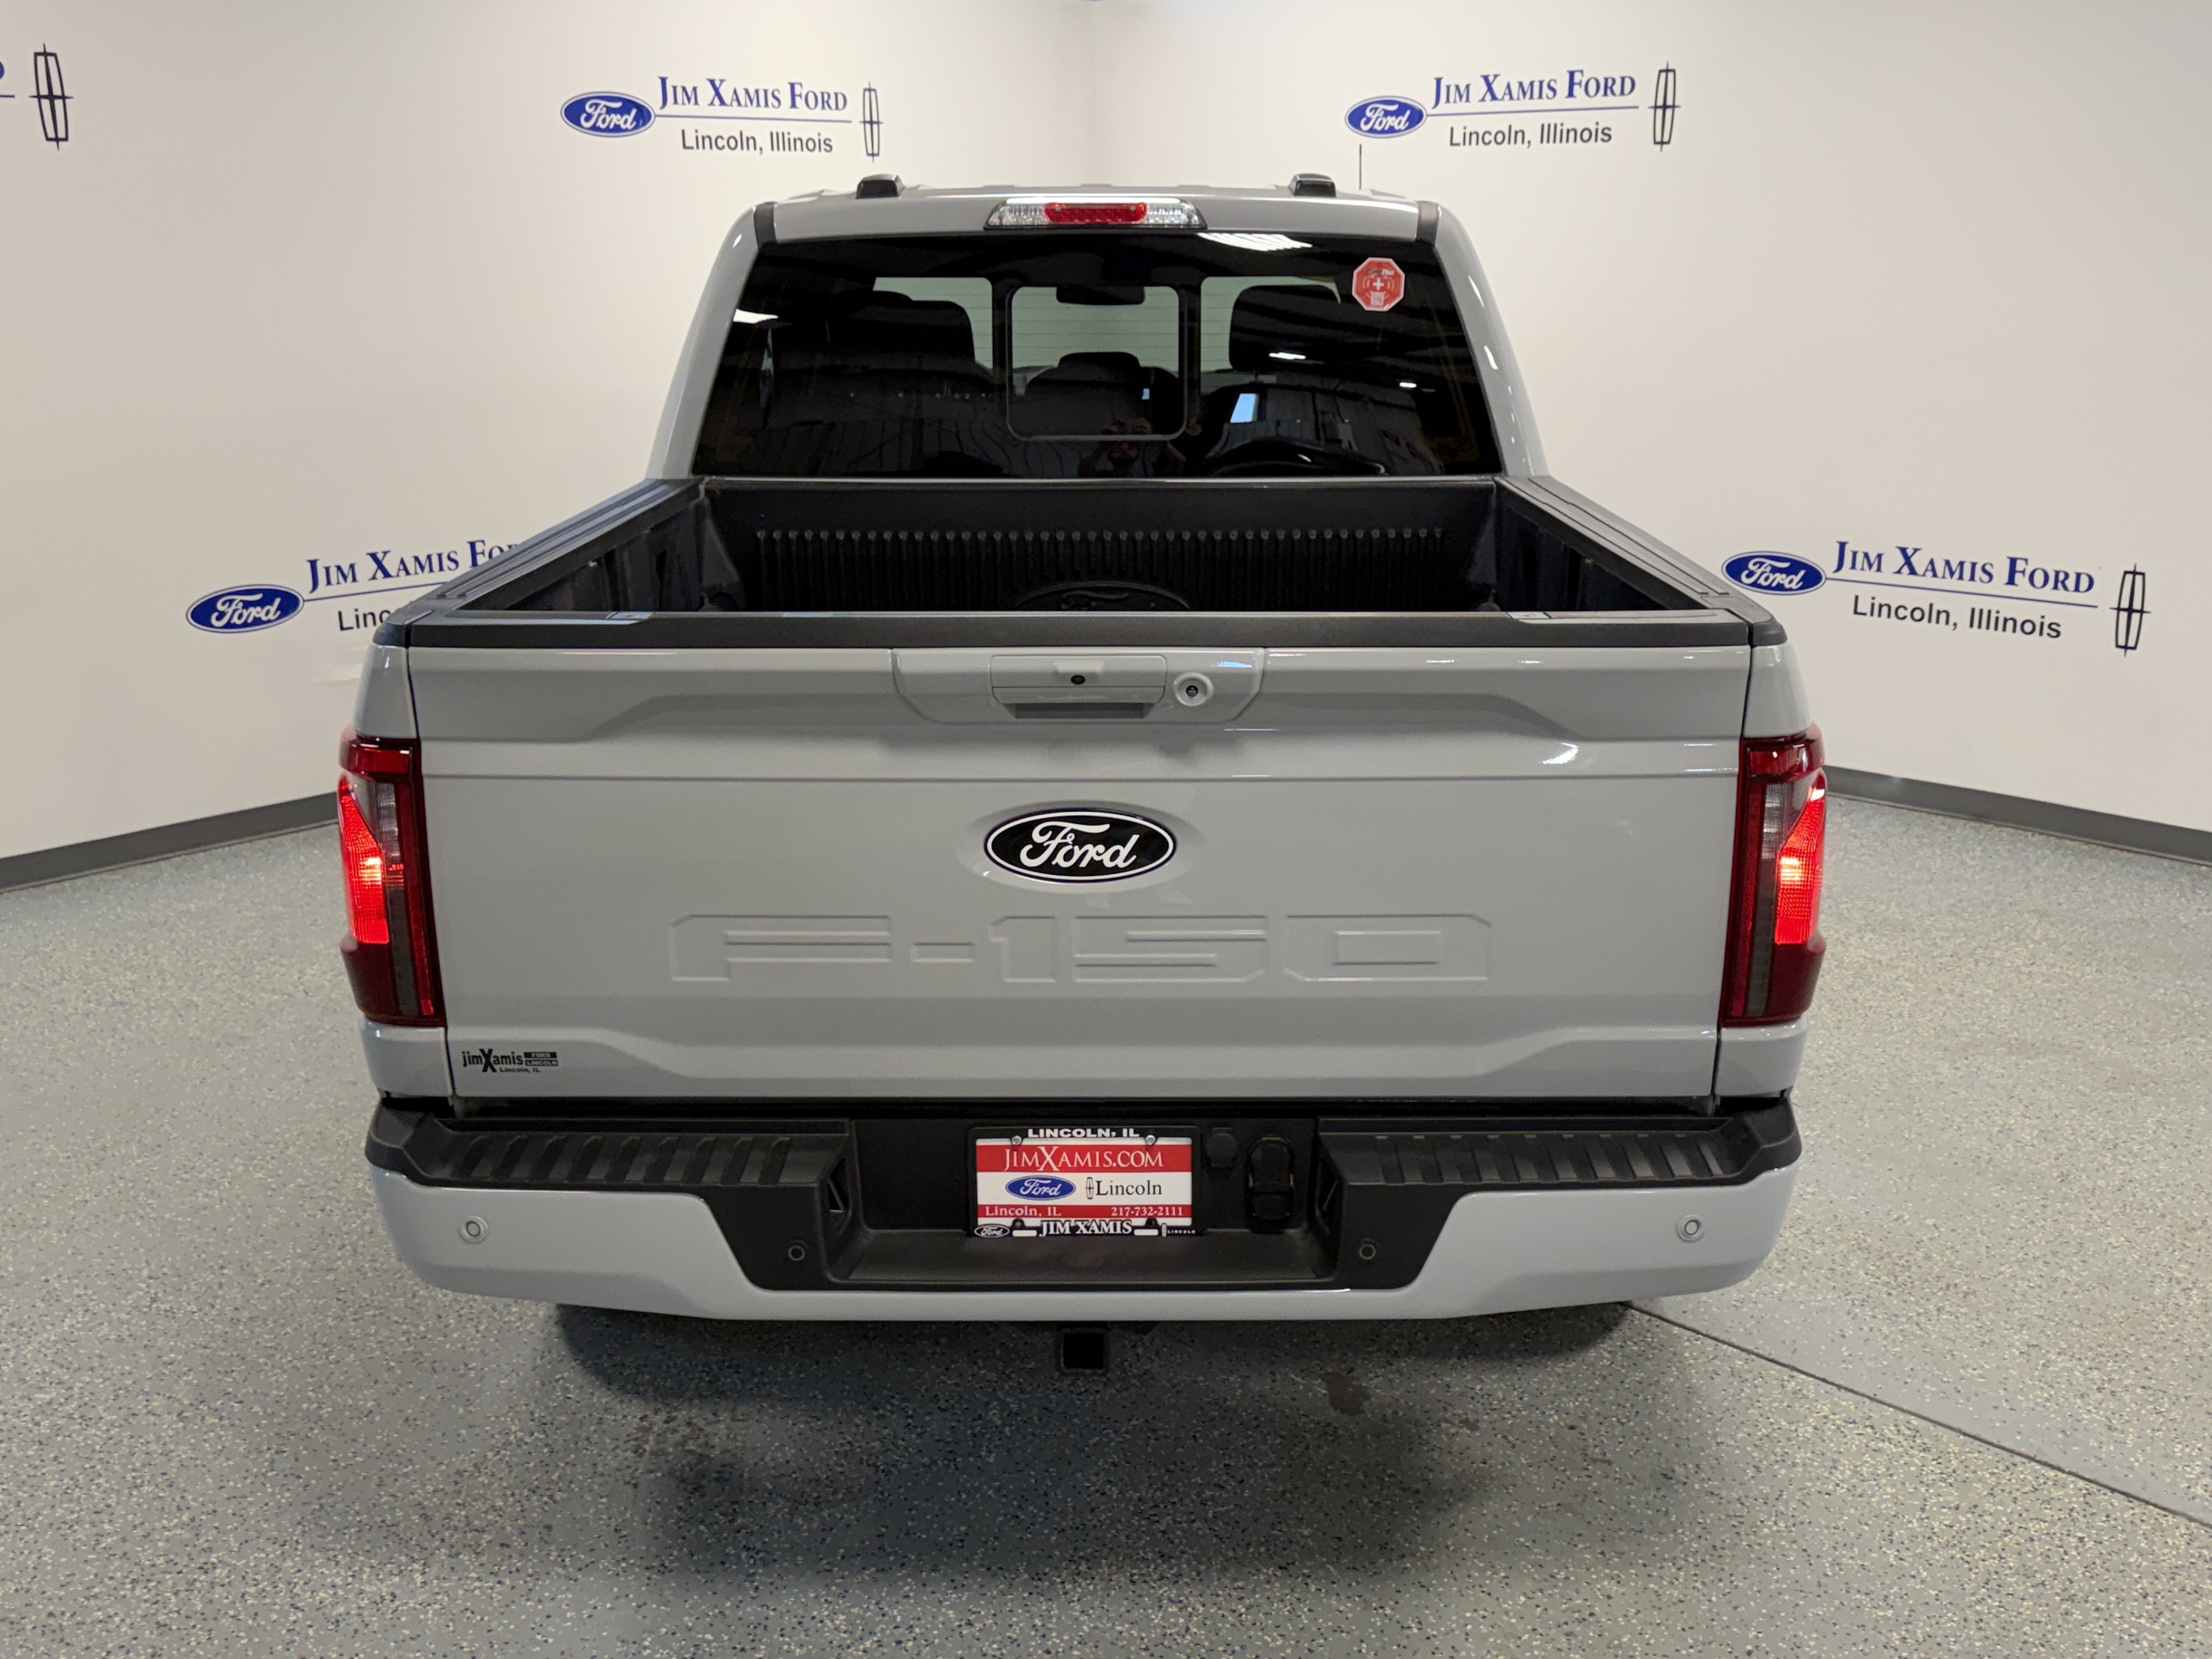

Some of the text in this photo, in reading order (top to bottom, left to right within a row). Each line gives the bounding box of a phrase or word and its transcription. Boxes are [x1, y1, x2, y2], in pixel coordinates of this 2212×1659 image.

[658, 76, 848, 111] JIM XAMIS FORD
[1431, 70, 1637, 110] JIM XAMIS FORD
[580, 99, 636, 130] Ford
[1359, 103, 1409, 132] Ford
[681, 129, 833, 154] Lincoln, Illinois
[1449, 122, 1612, 149] Lincoln, Illinois
[306, 539, 517, 595] JIM XAMIS FO
[1740, 557, 1803, 590] Ford
[1832, 540, 2096, 594] JIM XAMIS FORD
[210, 593, 281, 628] Ford
[1853, 594, 2062, 639] Lincoln, Illinois
[1019, 820, 1140, 868] Ford
[669, 913, 1491, 983] F-150
[1028, 1128, 1140, 1138] LINCOLN, IL
[1003, 1146, 1164, 1172] JIMXAMIS.COM
[1019, 1178, 1062, 1196] Ford
[1096, 1180, 1163, 1195] Lincoln
[985, 1206, 1062, 1217] Lincoln, IL
[1111, 1207, 1183, 1216] 217-732-2111
[1039, 1220, 1132, 1237] JIM XAMIS
